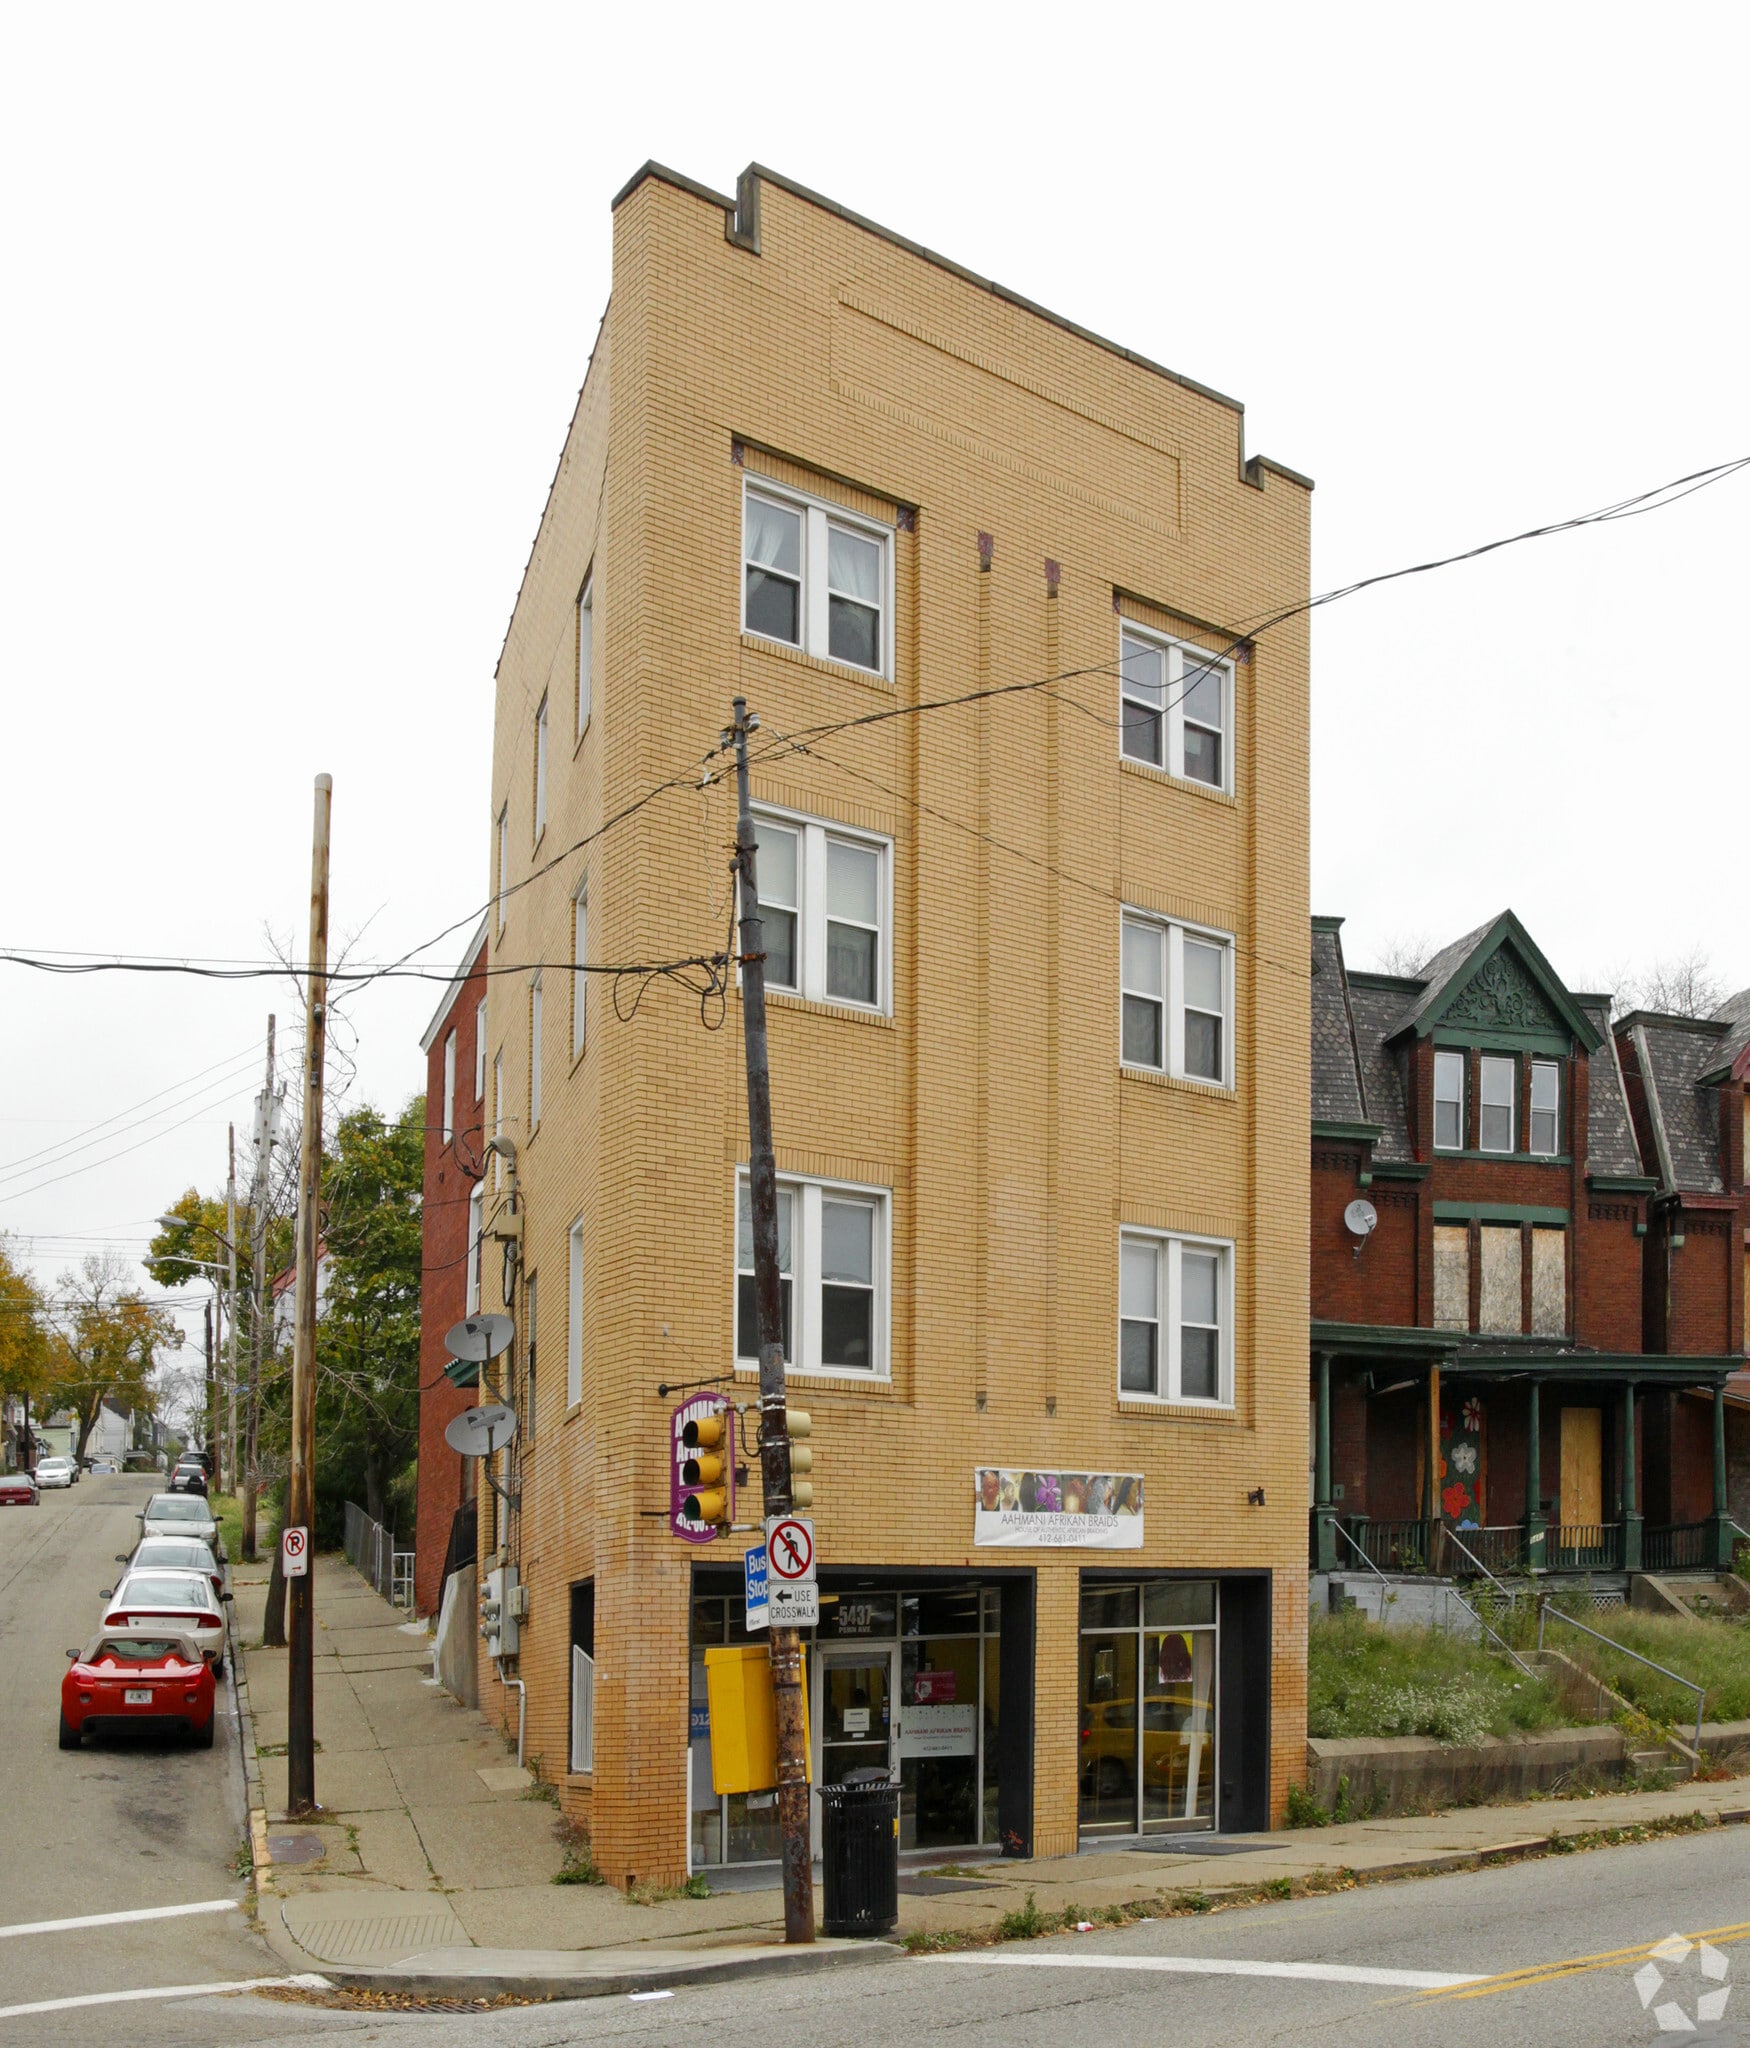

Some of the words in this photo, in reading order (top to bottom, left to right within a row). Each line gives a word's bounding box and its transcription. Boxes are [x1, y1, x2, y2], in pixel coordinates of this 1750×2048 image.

[1001, 1513, 1045, 1525] AAHMANI
[1048, 1514, 1086, 1526] AFRIKAN
[1088, 1515, 1119, 1527] BRAIDS
[1038, 1533, 1086, 1543] 412-661-0411
[748, 1555, 766, 1575] Bus
[748, 1579, 769, 1600] Stop
[794, 1589, 811, 1602] USE
[770, 1606, 816, 1619] CROSSWALK
[839, 1604, 872, 1626] 5437
